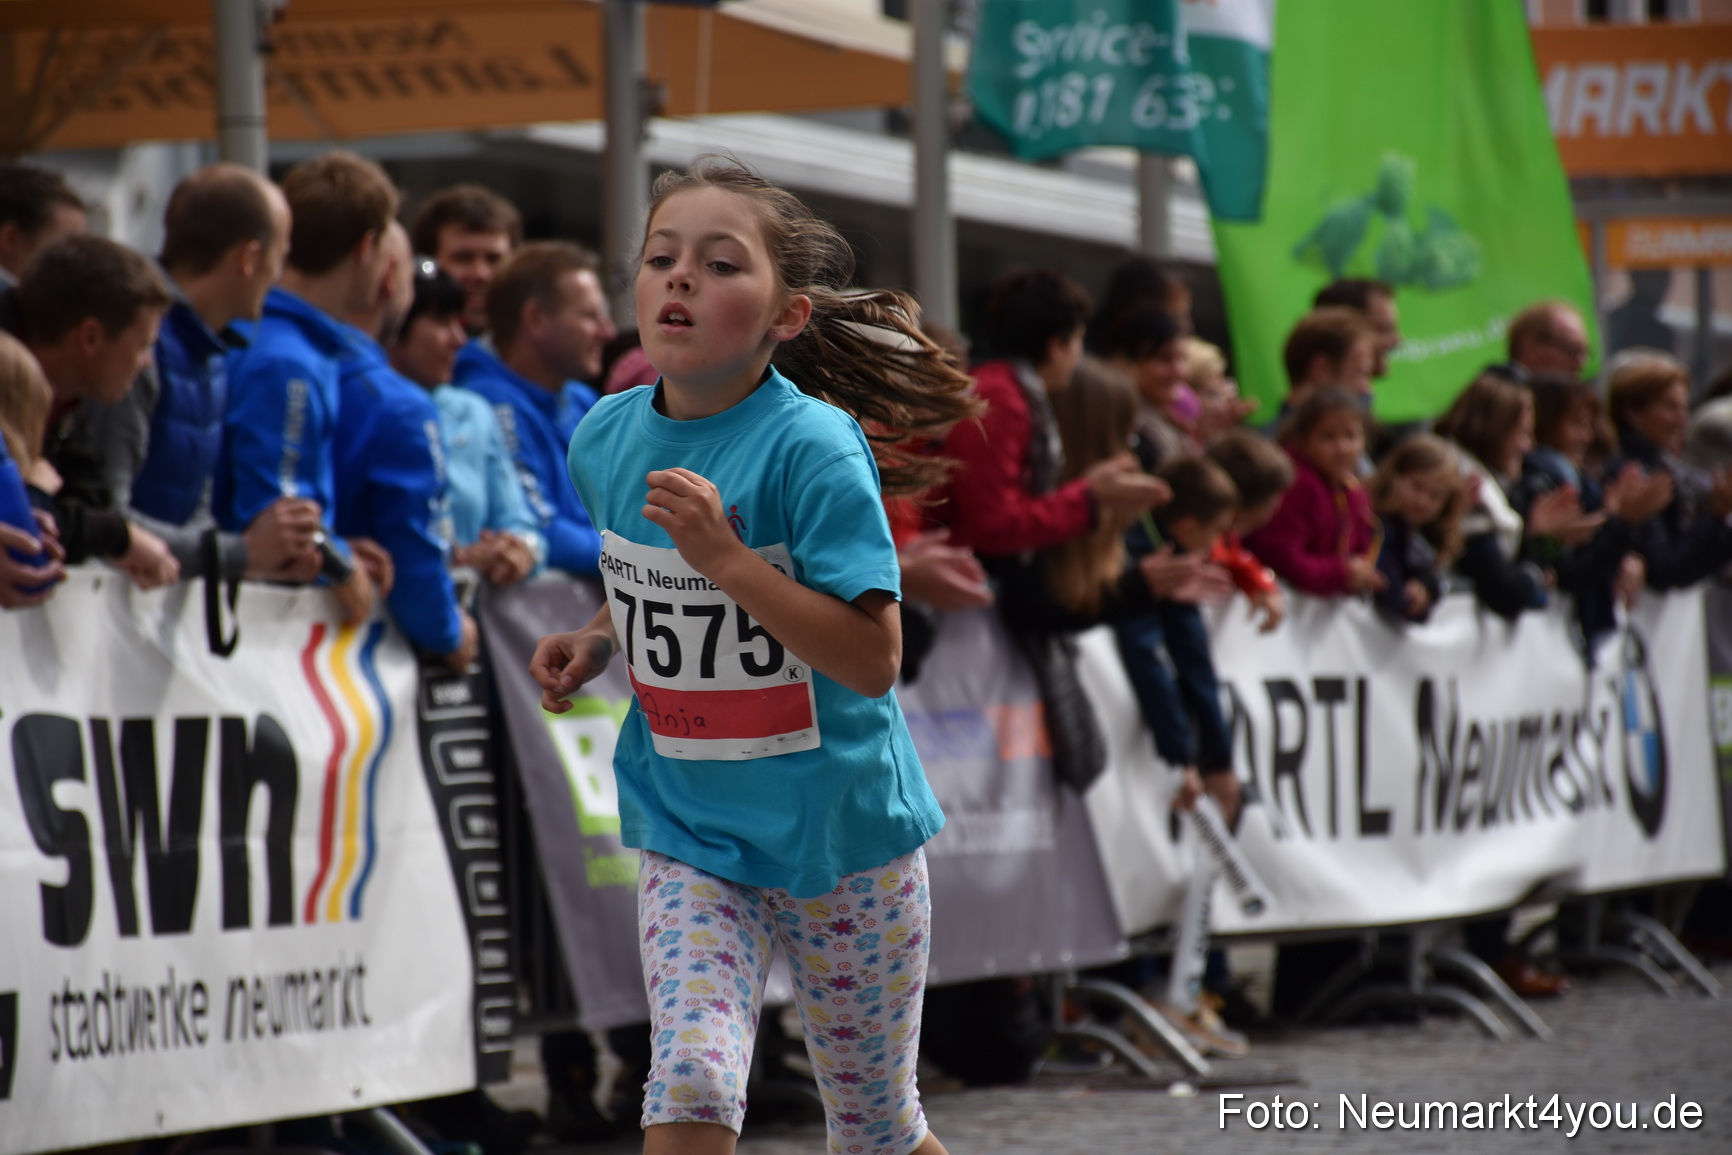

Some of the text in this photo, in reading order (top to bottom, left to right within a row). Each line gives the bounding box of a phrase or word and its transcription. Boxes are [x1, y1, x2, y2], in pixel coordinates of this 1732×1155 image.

[600, 550, 723, 591] PARTL Neuma
[613, 587, 785, 679] 7575
[788, 667, 799, 680] K
[638, 691, 706, 737] Anja
[1168, 676, 1394, 842] ARTL
[10, 711, 299, 948] swn
[49, 964, 209, 1064] stadtwerke
[223, 950, 373, 1042] neumarkt
